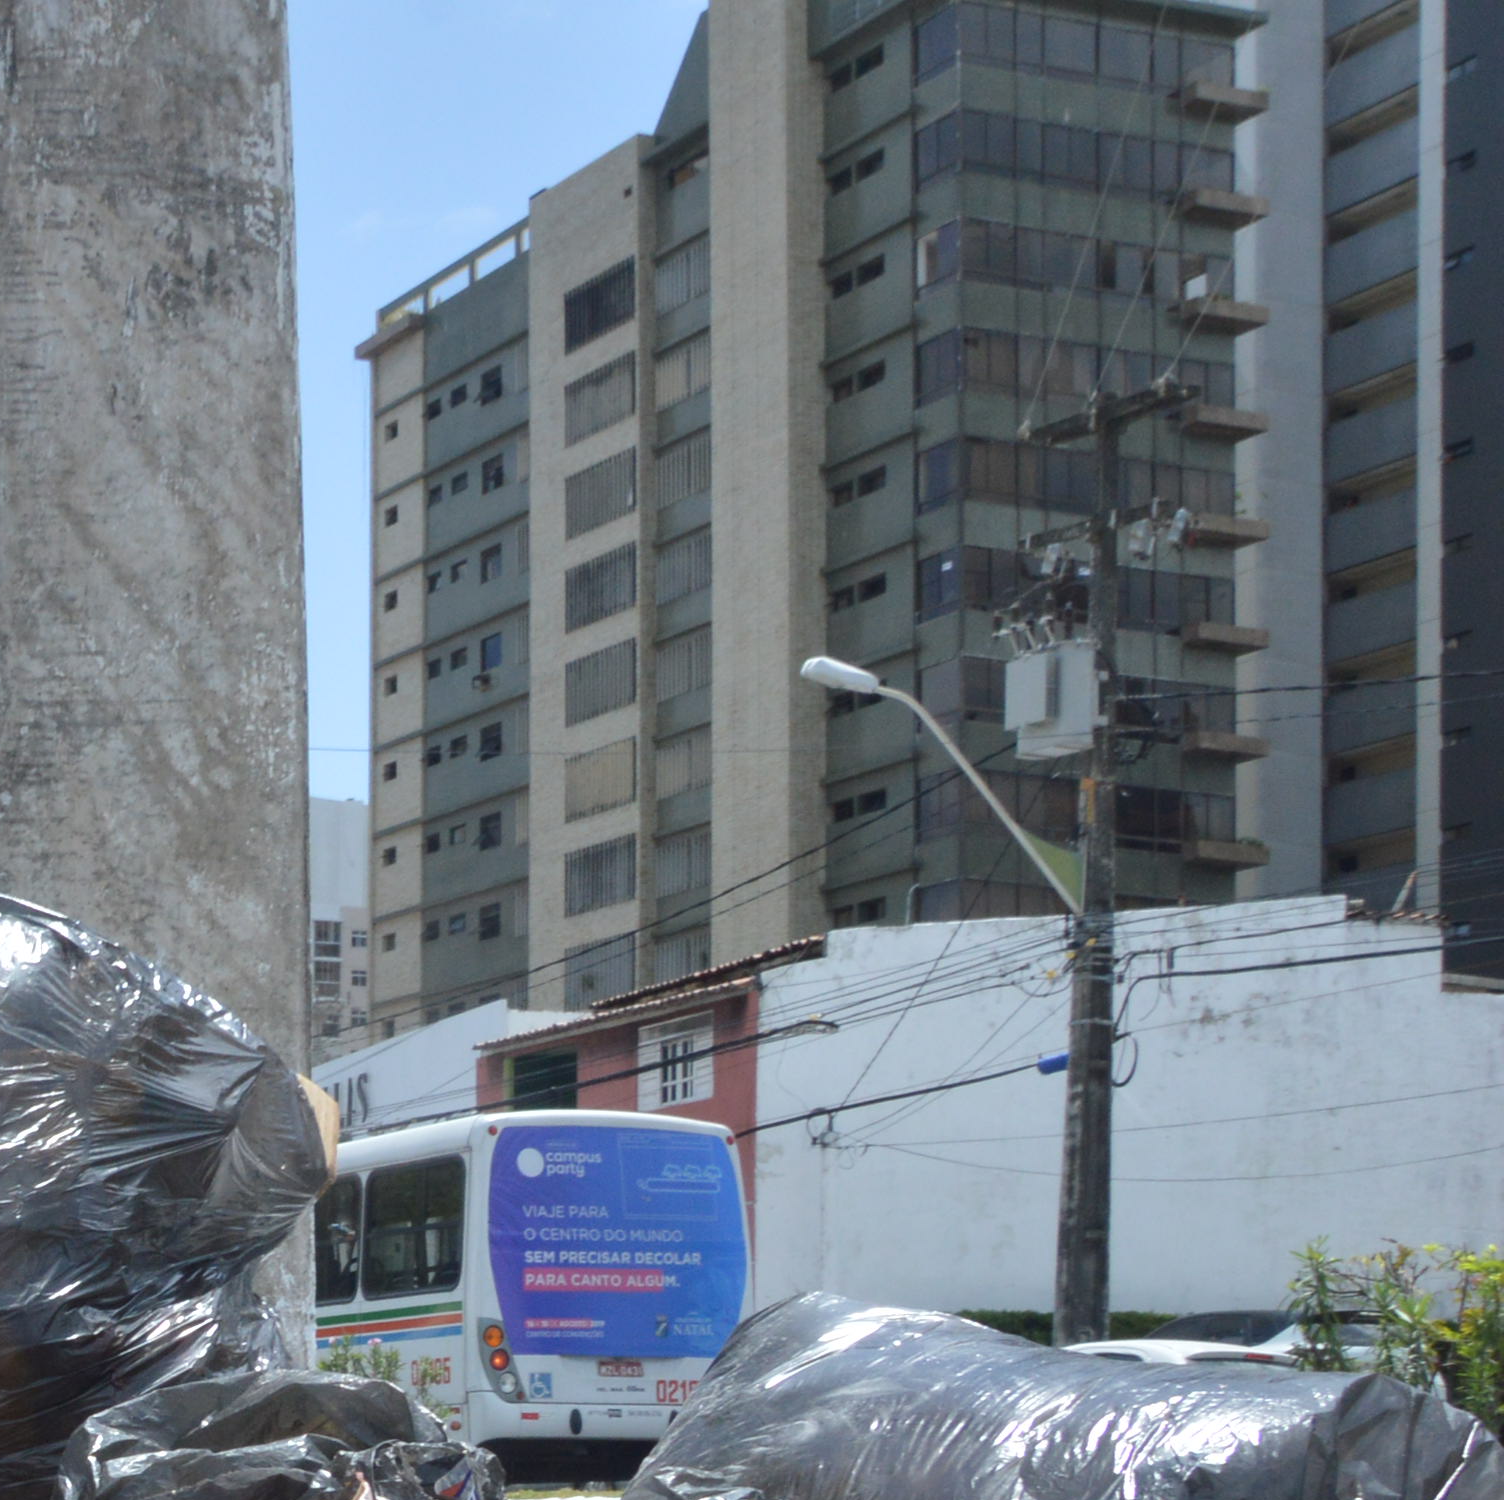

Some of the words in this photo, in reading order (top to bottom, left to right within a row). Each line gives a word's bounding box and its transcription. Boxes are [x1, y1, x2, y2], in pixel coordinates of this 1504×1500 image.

[545, 1150, 602, 1165] campus
[546, 1163, 585, 1179] party
[522, 1205, 565, 1218] VIAJE
[569, 1205, 609, 1218] PARA
[523, 1228, 536, 1241] O
[539, 1228, 600, 1241] CENTRO
[604, 1228, 626, 1241] DO
[630, 1229, 684, 1242] MUNDO
[524, 1251, 555, 1264] SEM
[559, 1251, 630, 1265] PRECISAR
[635, 1252, 702, 1266] DECOLAR
[525, 1273, 567, 1286] PARA
[571, 1274, 622, 1287] CANTO
[626, 1275, 680, 1288] ALGUM.
